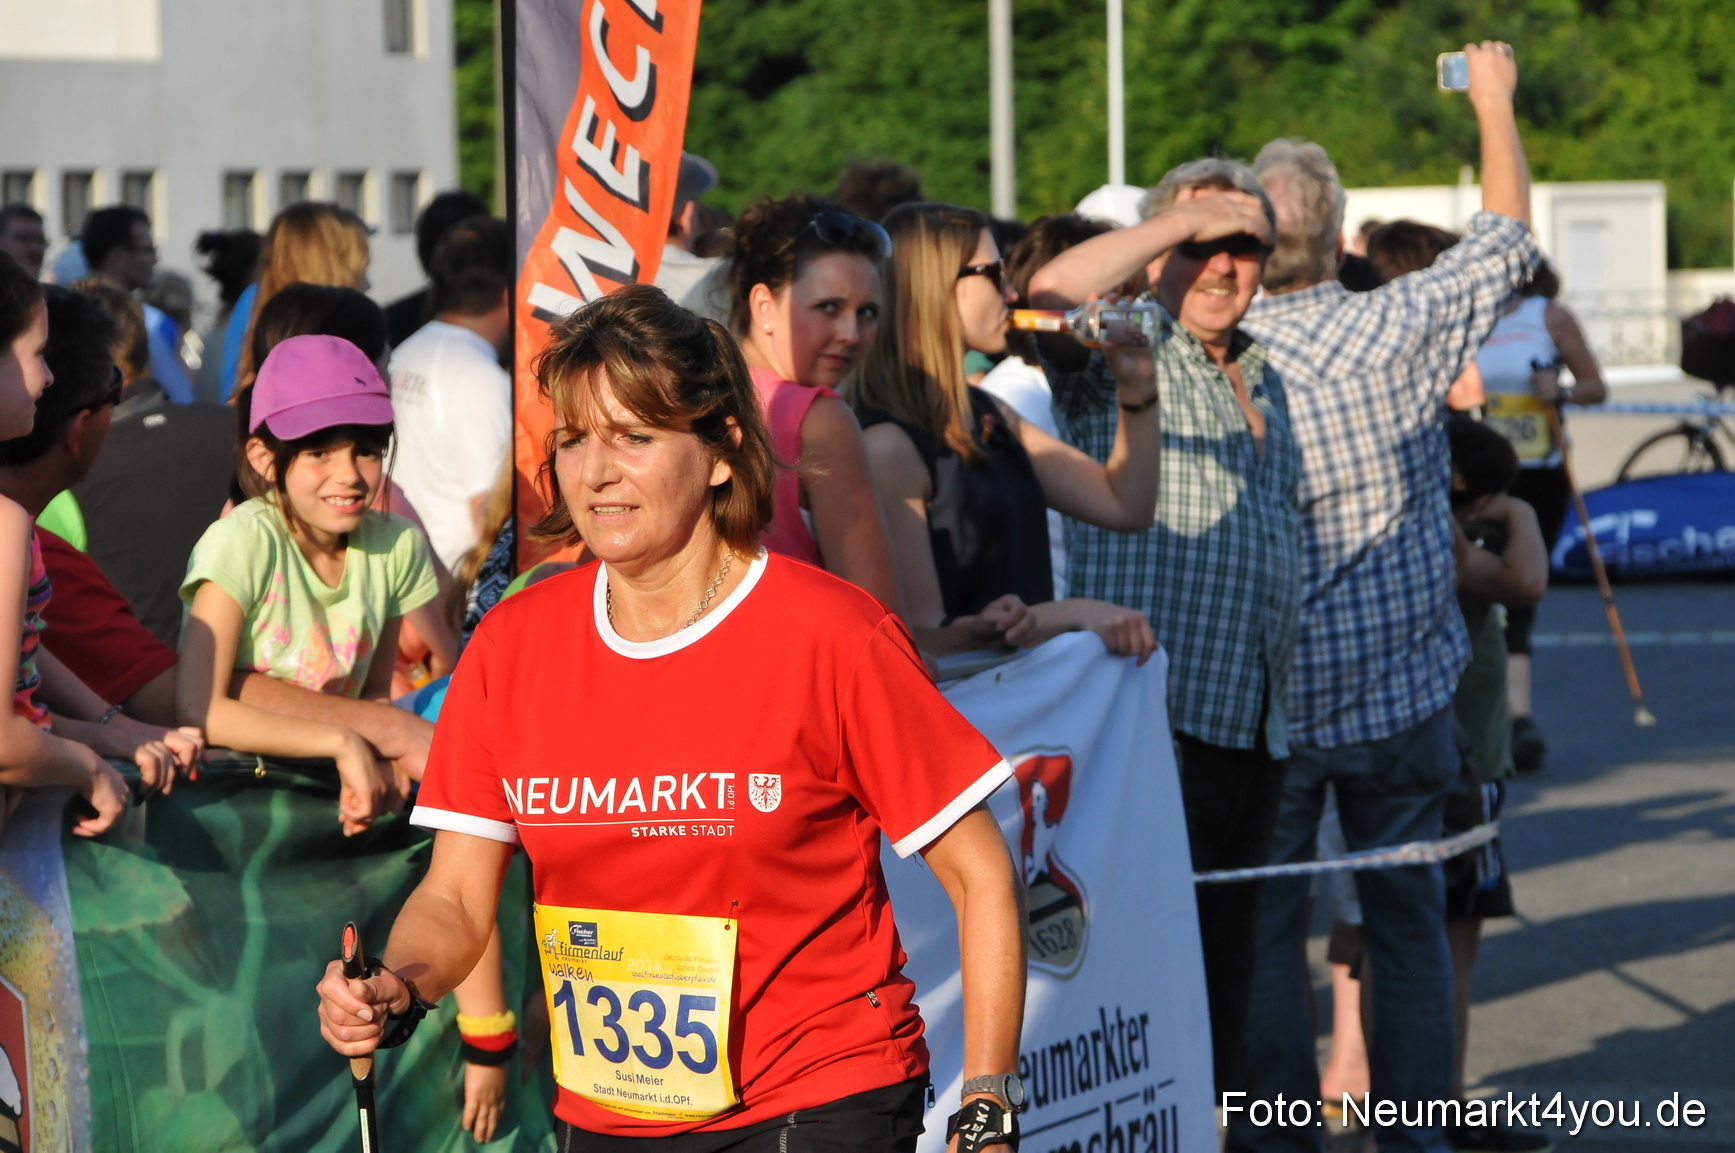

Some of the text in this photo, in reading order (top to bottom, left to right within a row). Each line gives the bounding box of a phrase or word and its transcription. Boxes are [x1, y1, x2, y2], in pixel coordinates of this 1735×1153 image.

[526, 0, 664, 318] WEC
[501, 772, 735, 815] NEUMARKT
[631, 824, 735, 838] STARKE STADT
[560, 941, 624, 962] firmenlauf
[1030, 917, 1077, 959] 1628
[549, 963, 594, 982] walken
[626, 958, 662, 973] 2014
[554, 980, 718, 1075] 1335
[1018, 1005, 1149, 1114] eumarkter
[615, 1069, 664, 1086] Susi Meier
[593, 1083, 693, 1106] Stadt Neumarkt i.d.OPf.
[965, 1103, 990, 1142] LEKI
